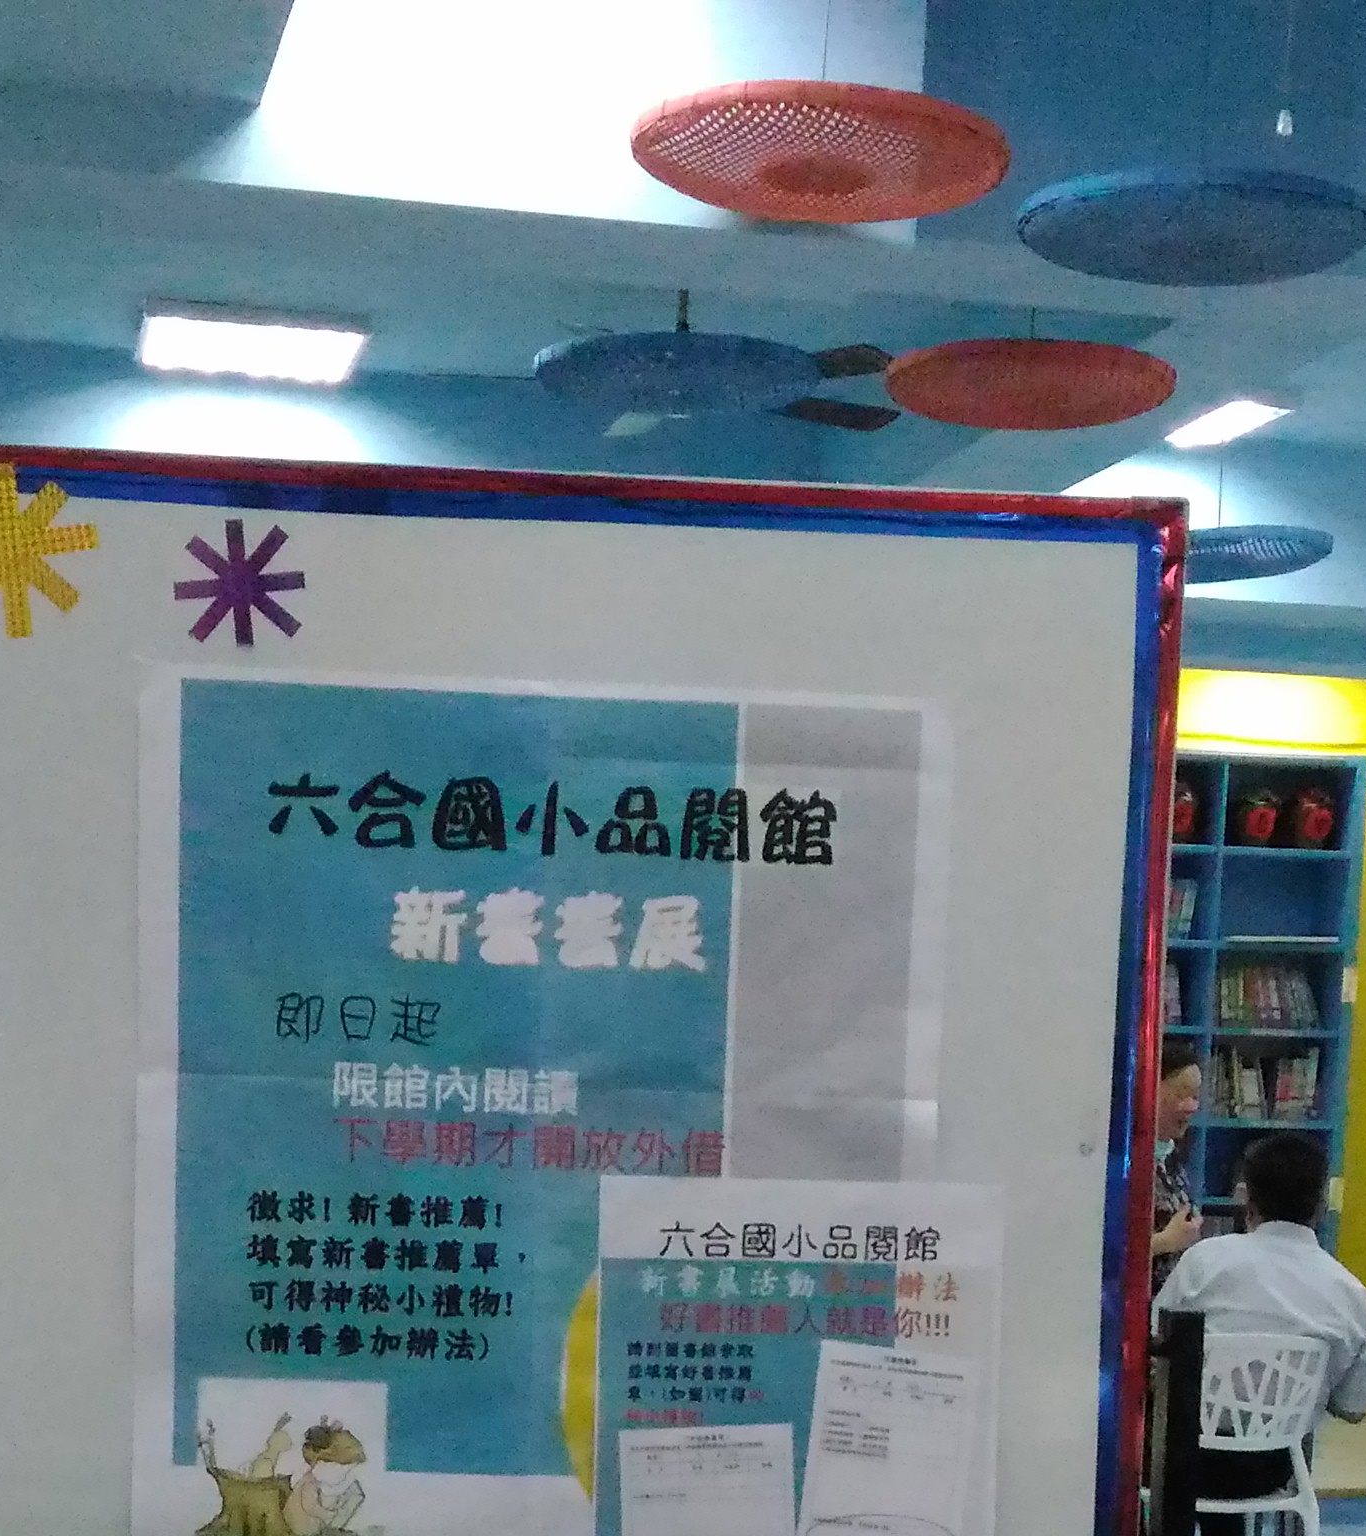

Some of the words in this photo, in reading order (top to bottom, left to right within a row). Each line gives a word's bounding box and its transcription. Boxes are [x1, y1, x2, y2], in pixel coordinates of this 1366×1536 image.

[267, 770, 838, 867] 六合國小品閱館
[276, 993, 443, 1046] 即日起
[332, 1061, 580, 1117] 限館內閱讀
[659, 1221, 942, 1263] 六合國小品閱館
